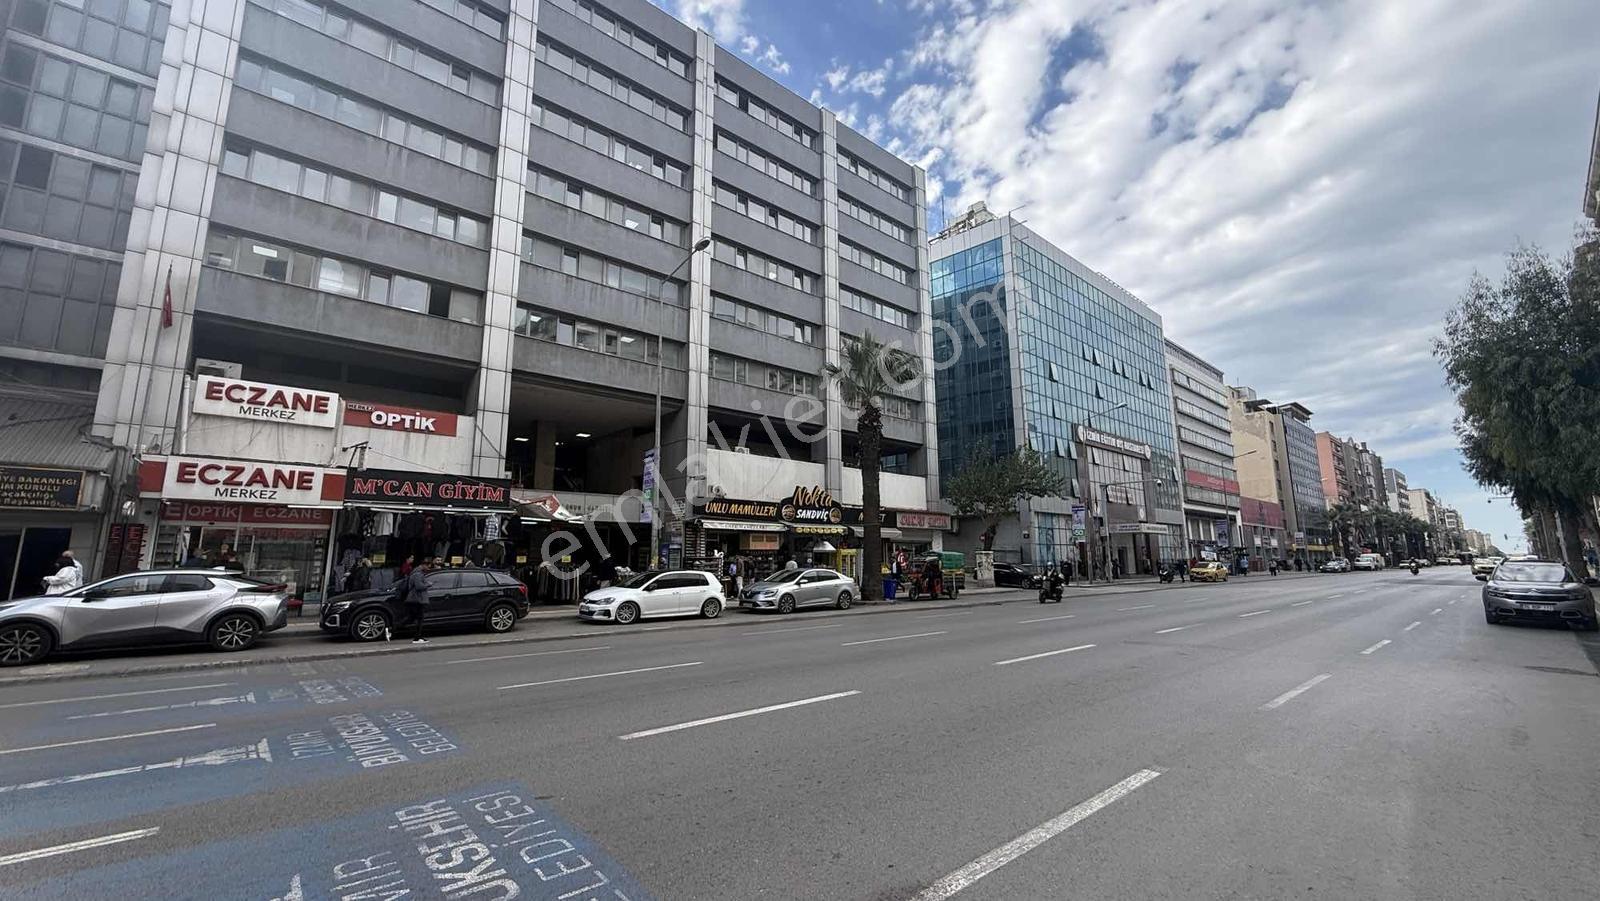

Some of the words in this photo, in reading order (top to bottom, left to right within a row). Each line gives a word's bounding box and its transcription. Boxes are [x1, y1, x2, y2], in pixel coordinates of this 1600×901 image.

[205, 380, 331, 414] ECZANE
[239, 405, 297, 421] MERKEZ
[370, 411, 436, 432] OPTİK
[176, 461, 315, 491] ECZANE
[214, 487, 278, 500] MERKEZ
[438, 480, 504, 502] GİYİM
[793, 484, 833, 507] Nokta
[189, 504, 240, 518] OPTİK
[253, 506, 322, 520] ECZANE
[705, 502, 728, 514] UNLU
[728, 502, 777, 517] MAMÜLLERİ
[796, 508, 829, 522] SANDVİÇ
